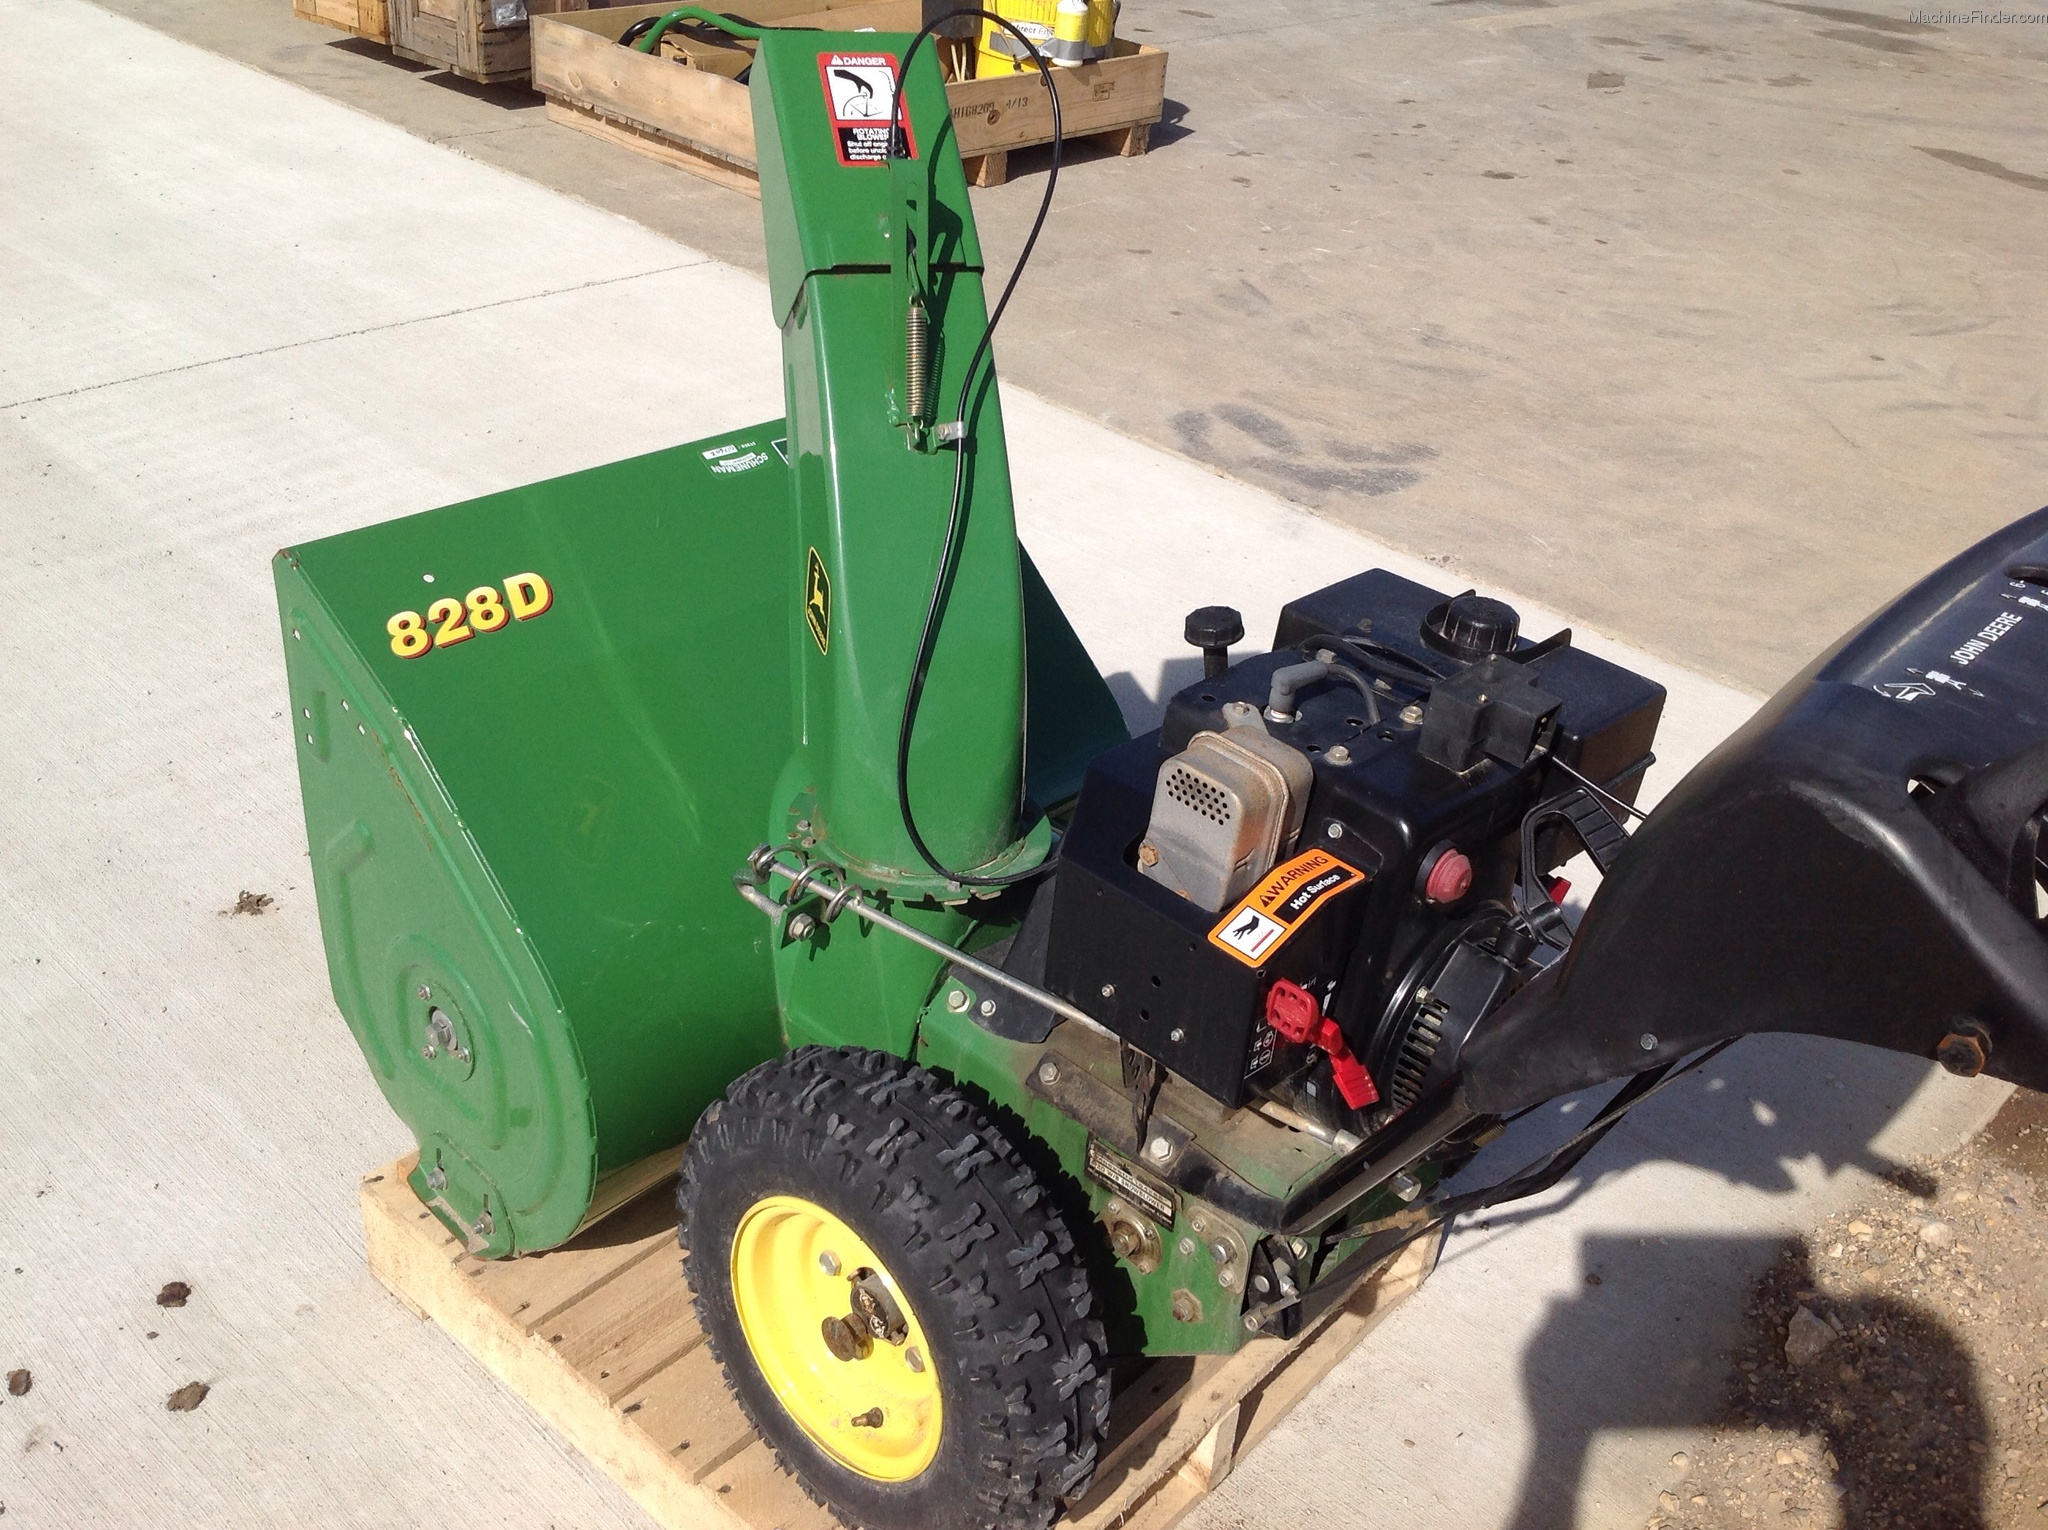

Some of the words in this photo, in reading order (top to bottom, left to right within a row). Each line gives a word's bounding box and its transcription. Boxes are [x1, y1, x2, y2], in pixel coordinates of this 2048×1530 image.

[843, 57, 886, 66] DANGER
[710, 452, 769, 473] SCHUNEMAN
[386, 572, 554, 660] 828D
[1950, 639, 1990, 666] JOHN
[1977, 611, 2024, 642] DEERE
[1268, 855, 1329, 896] WARNING
[1290, 891, 1312, 911] Hot
[1306, 873, 1341, 894] Surface
